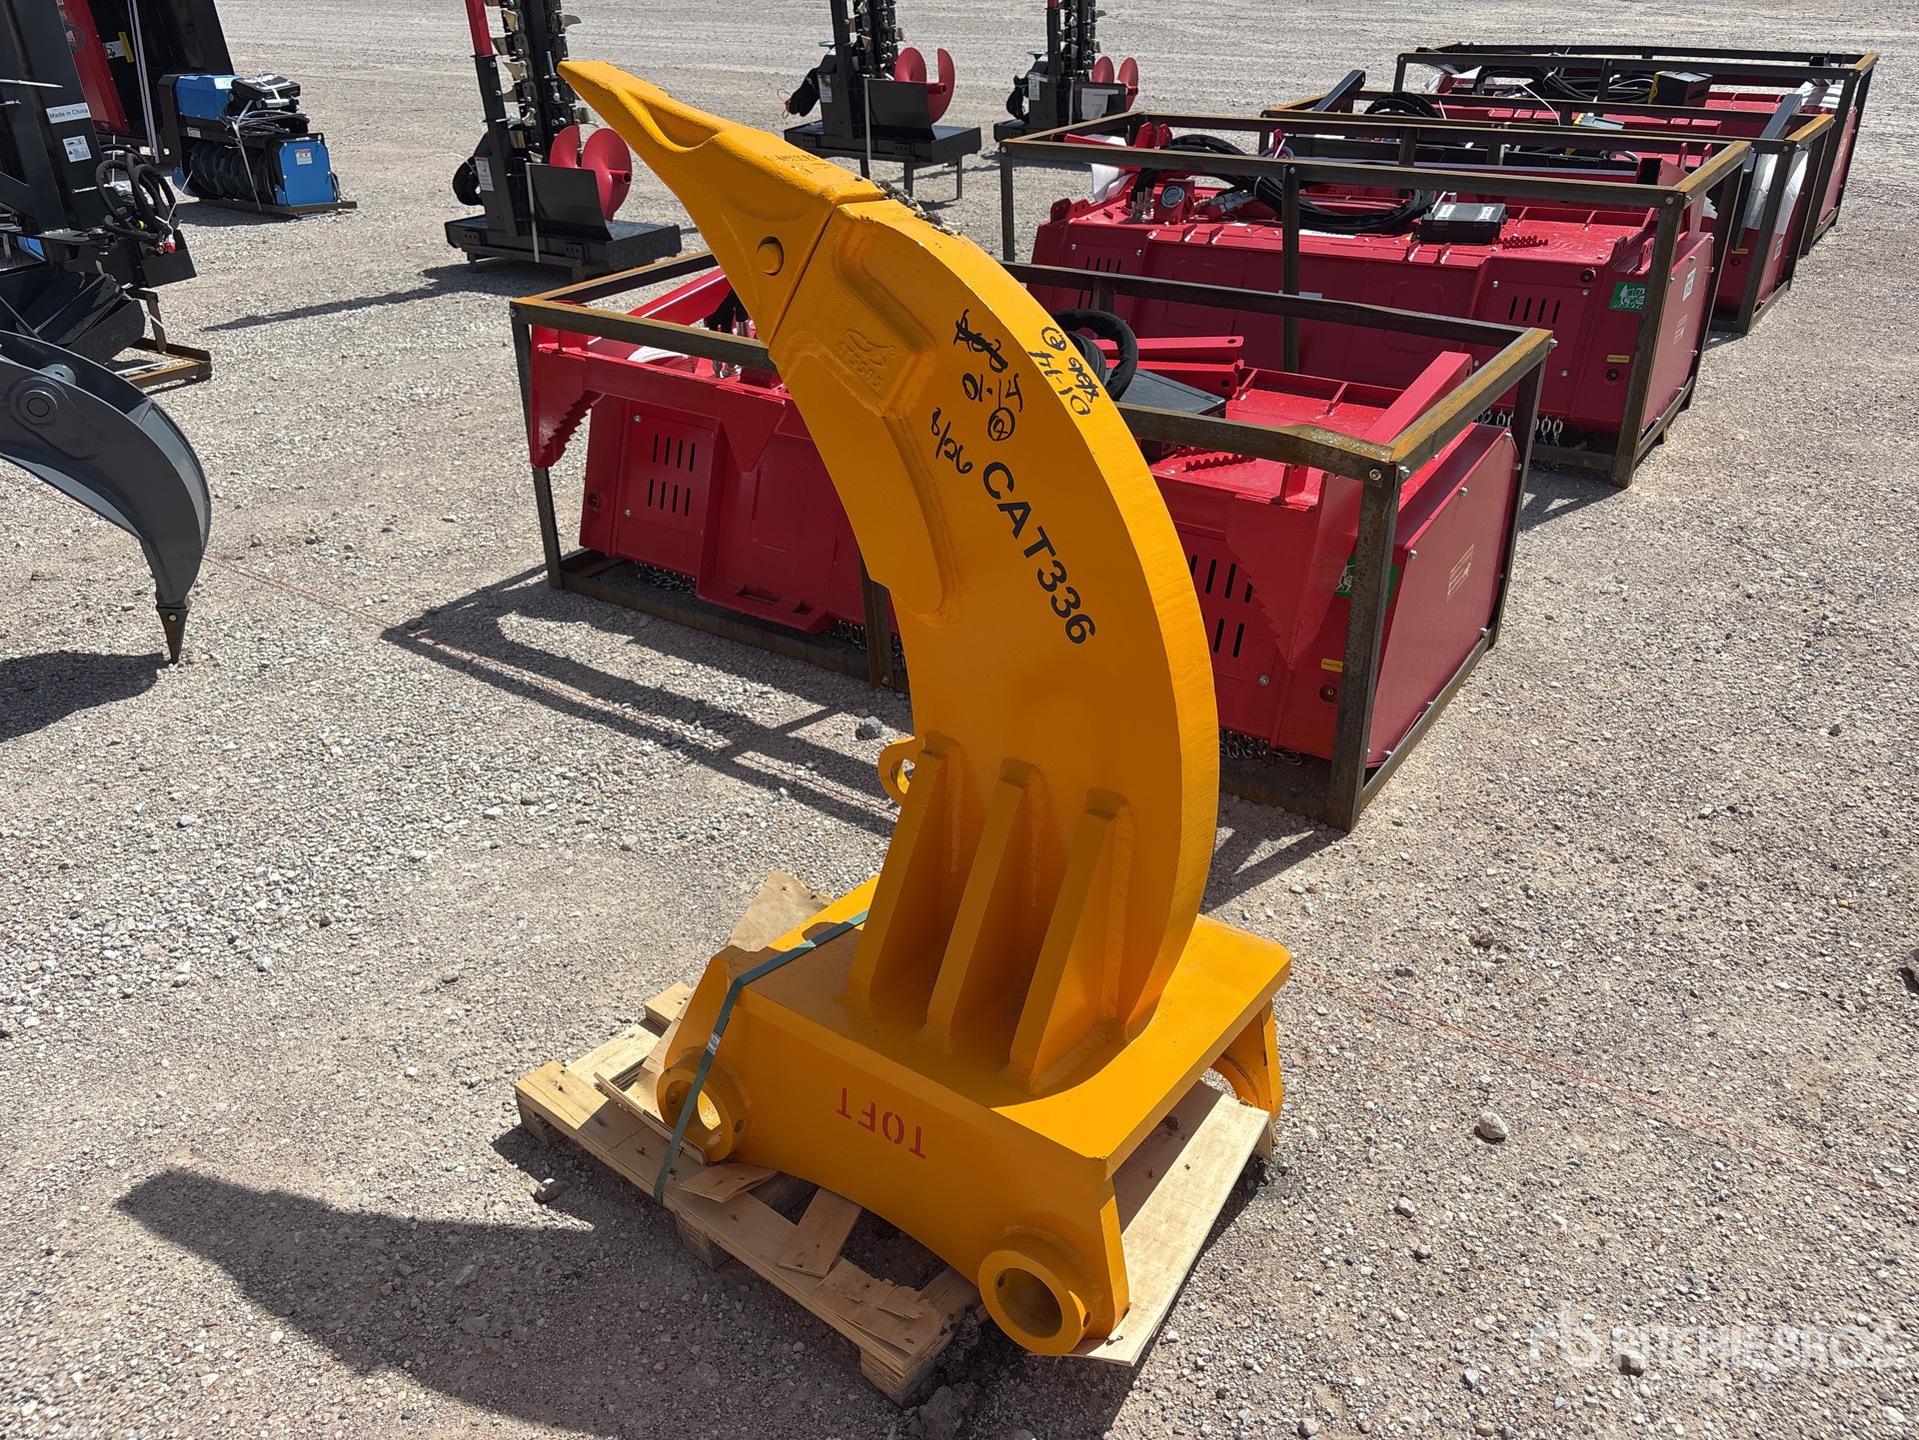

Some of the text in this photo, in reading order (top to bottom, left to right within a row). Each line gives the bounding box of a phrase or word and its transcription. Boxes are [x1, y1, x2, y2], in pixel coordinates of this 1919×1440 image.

[72, 108, 88, 116] China
[982, 461, 1097, 645] CAT336
[836, 1087, 927, 1160] TOFT
